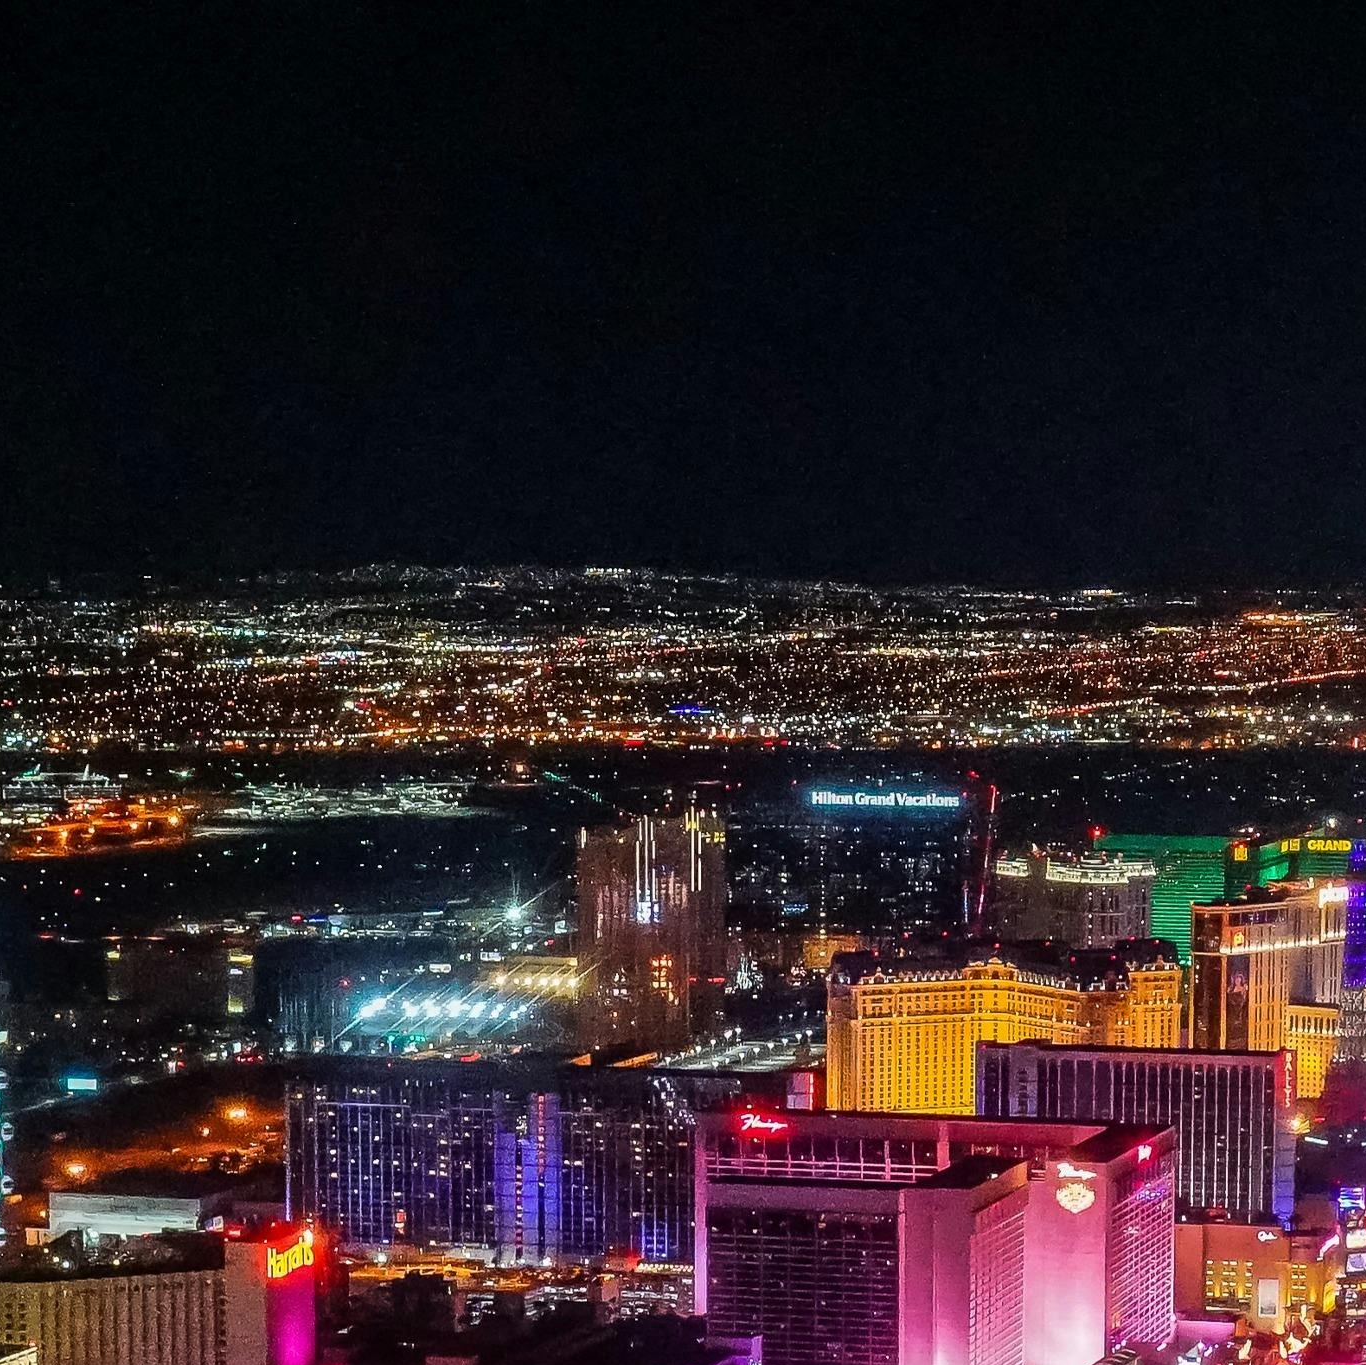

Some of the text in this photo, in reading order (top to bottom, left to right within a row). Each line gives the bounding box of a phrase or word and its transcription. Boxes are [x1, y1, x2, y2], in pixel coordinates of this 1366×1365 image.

[811, 791, 960, 807] Hilton Grand Vacations
[1307, 840, 1351, 851] GRAND
